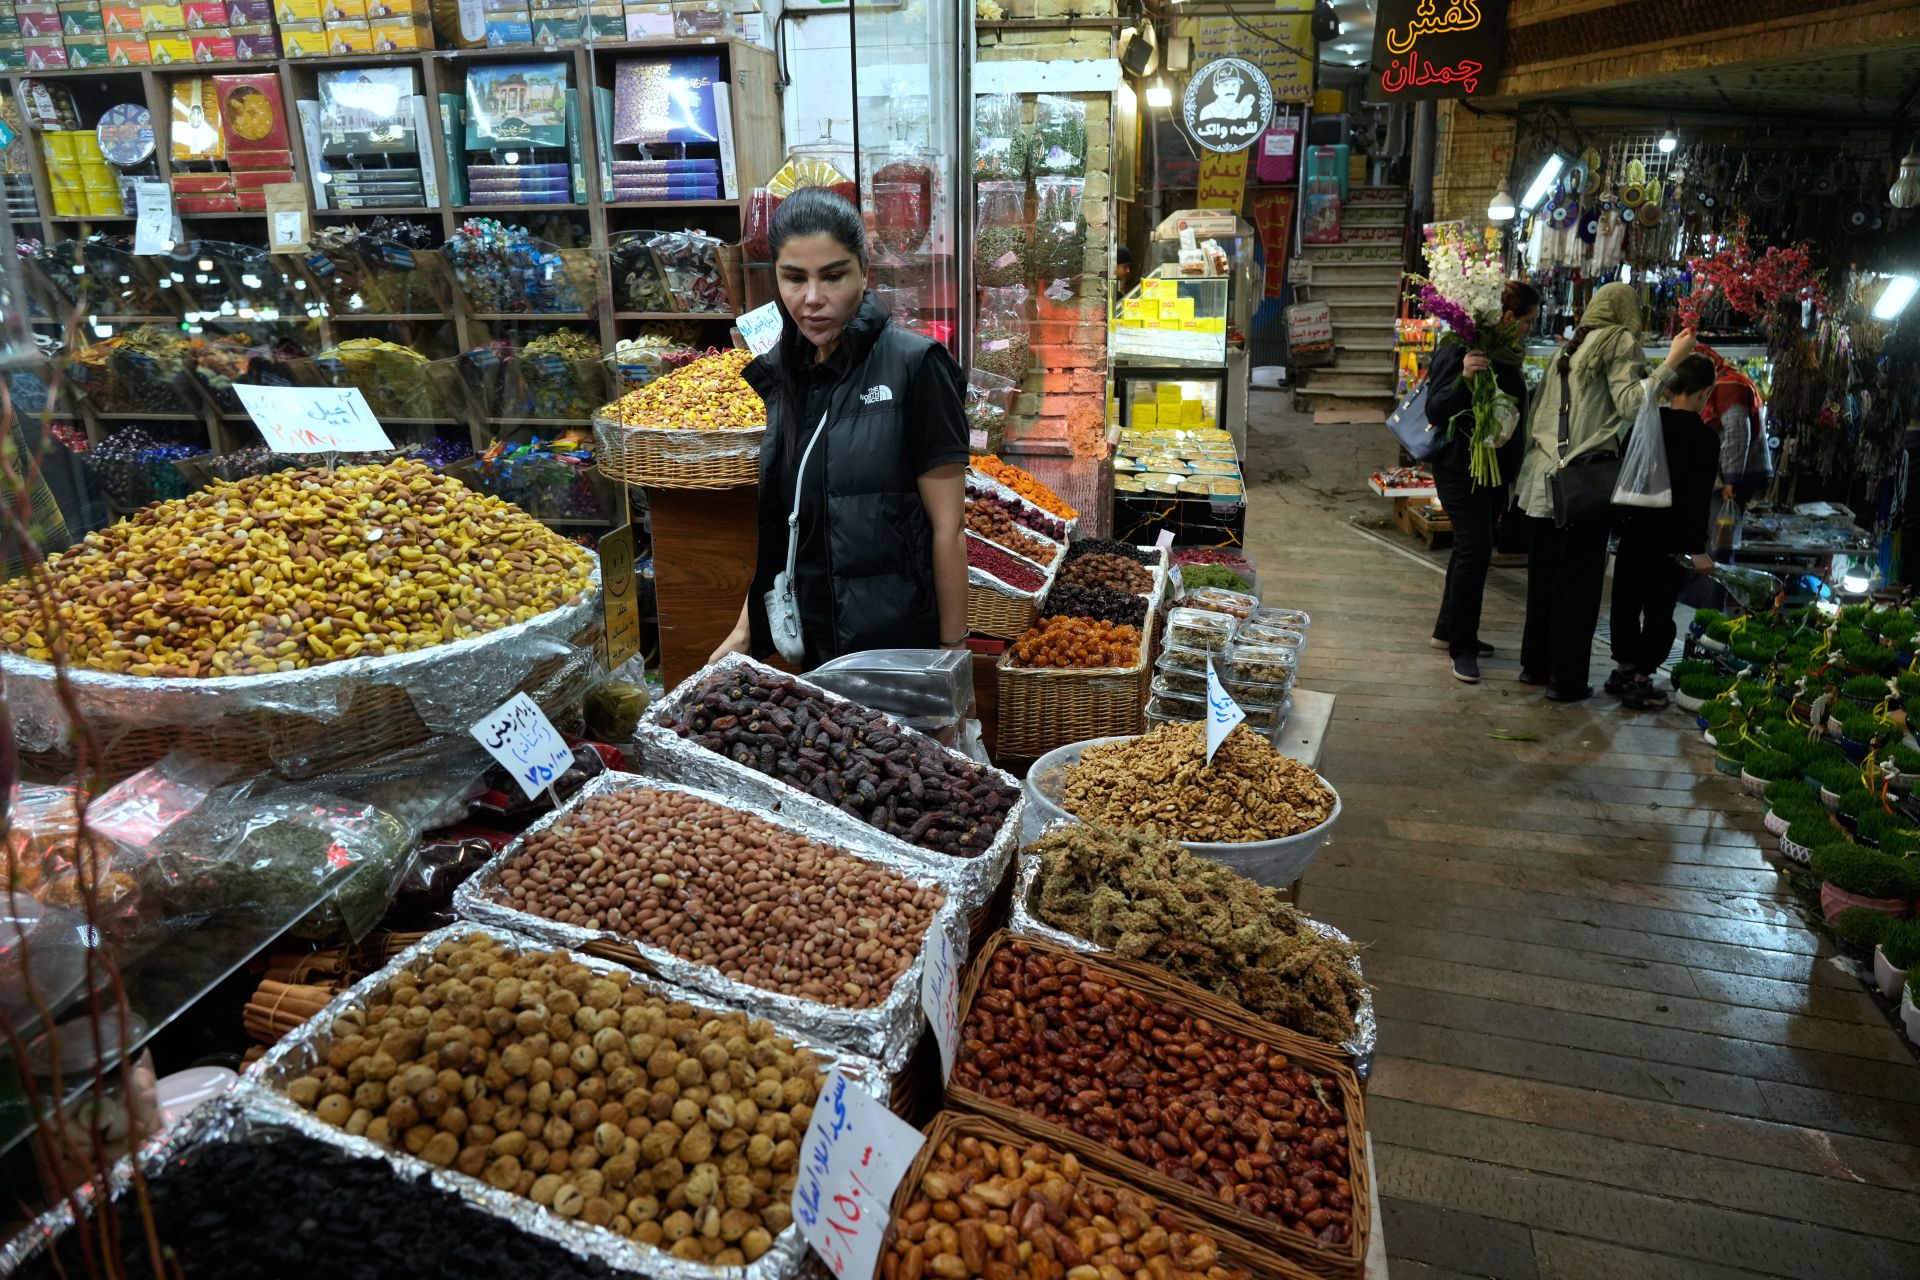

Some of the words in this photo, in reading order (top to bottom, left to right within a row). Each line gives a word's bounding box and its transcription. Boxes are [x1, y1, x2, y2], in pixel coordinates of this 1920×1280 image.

[1387, 0, 1481, 54] کفش
[1382, 51, 1482, 93] چمدان
[1229, 120, 1258, 137] لقمه
[1202, 164, 1242, 181] کفش
[1199, 185, 1241, 206] چمدان
[860, 390, 880, 400] NORTH
[868, 386, 879, 394] THE
[307, 391, 361, 426] آجیل
[515, 699, 537, 729] بادام
[486, 712, 518, 750] زمینی
[825, 1075, 853, 1141] سنجد
